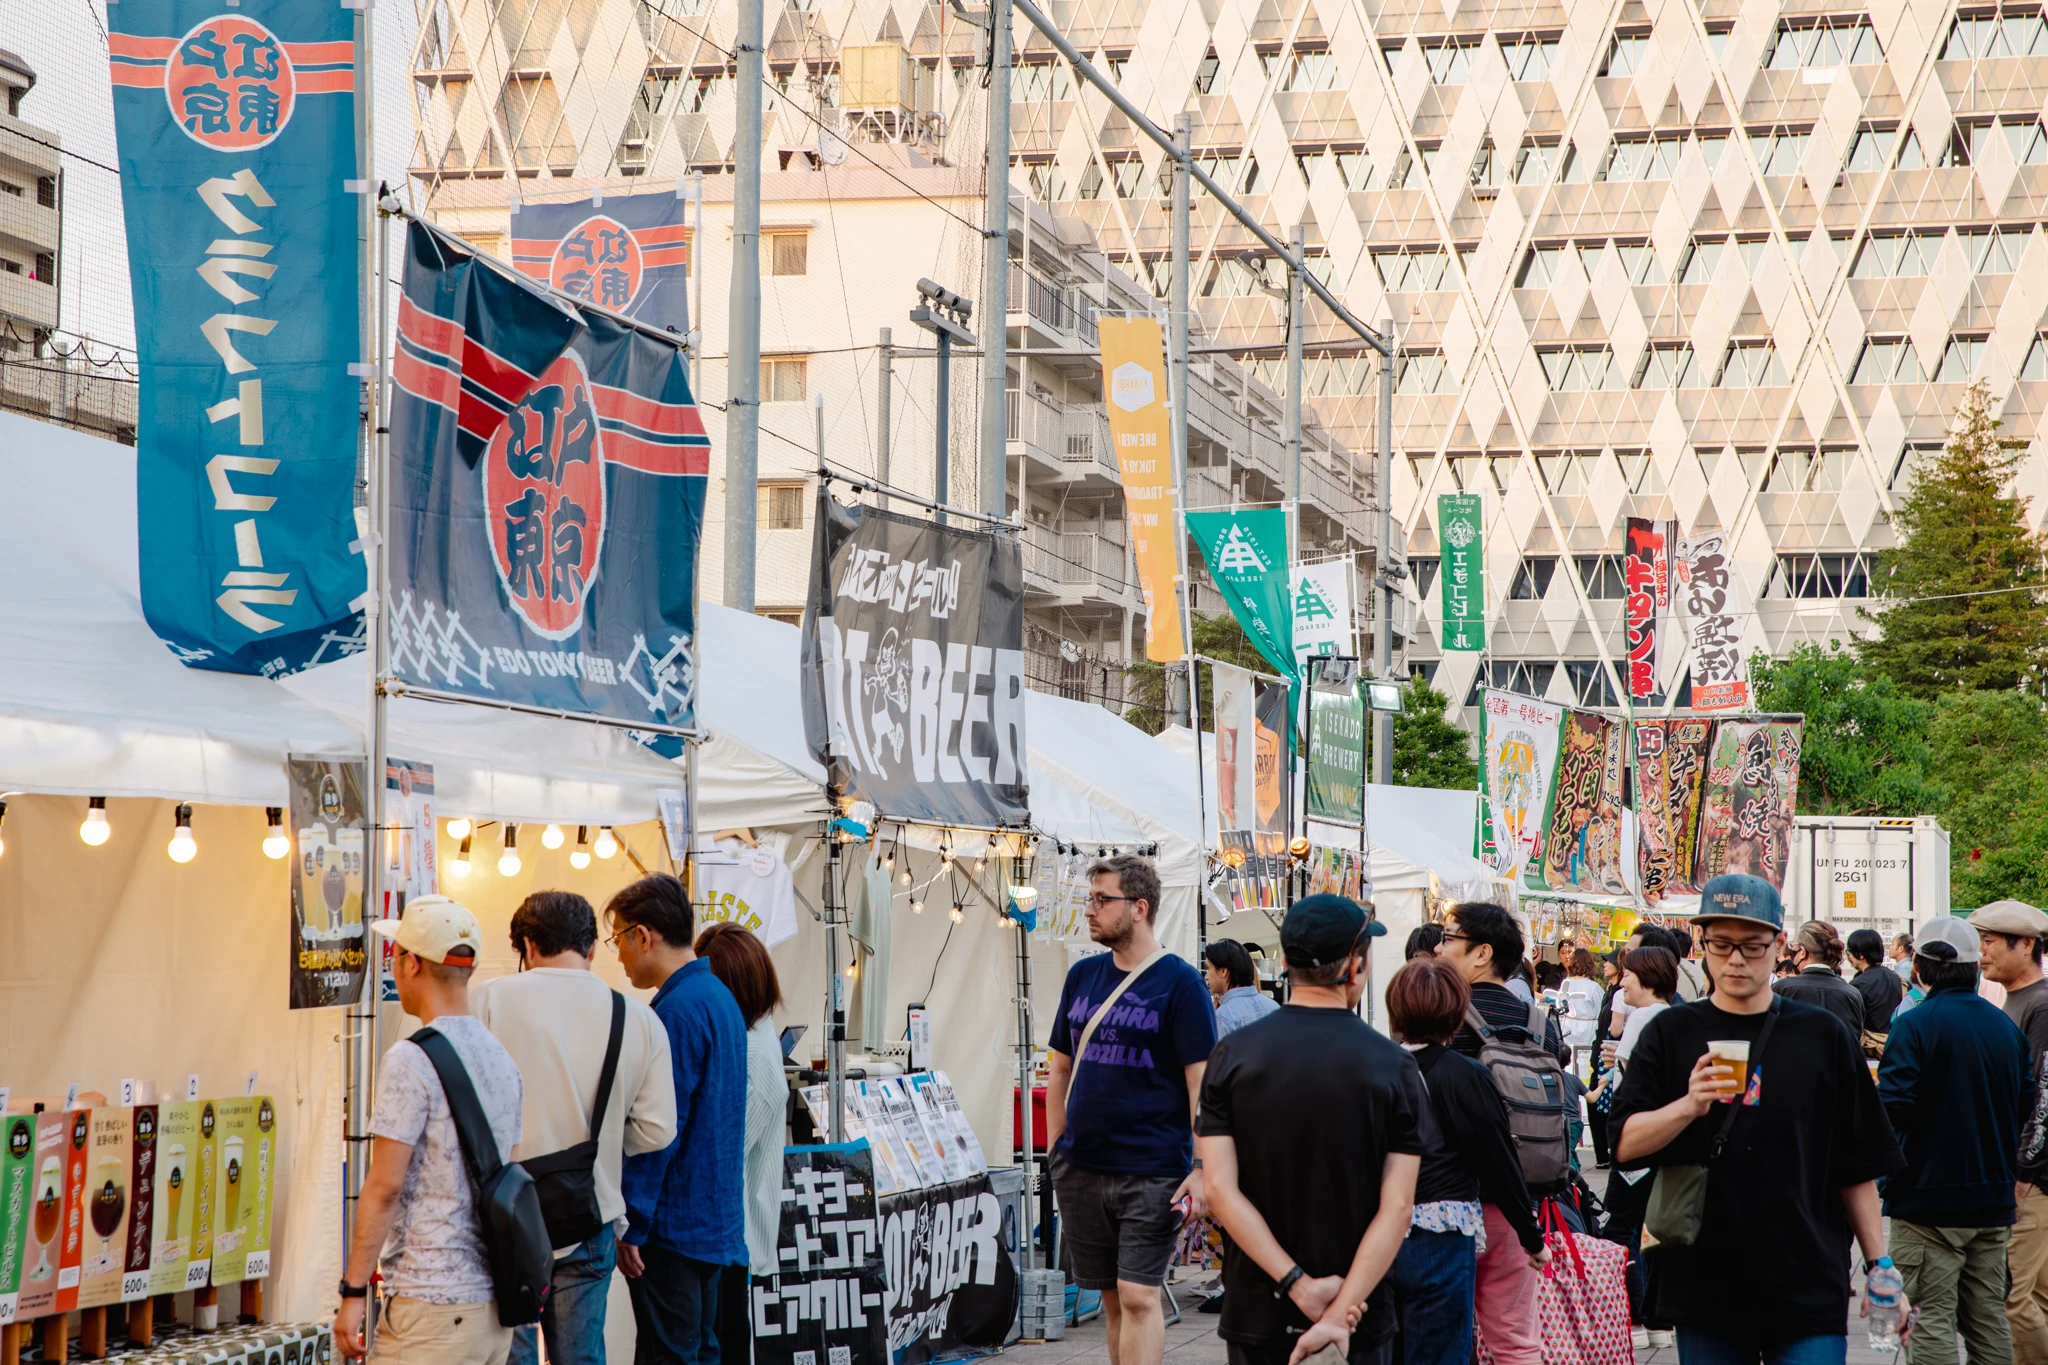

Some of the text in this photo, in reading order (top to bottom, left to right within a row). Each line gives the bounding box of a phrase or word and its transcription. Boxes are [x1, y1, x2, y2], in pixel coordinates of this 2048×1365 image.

[505, 382, 597, 488] 江戸
[504, 485, 589, 606] 東京
[1654, 558, 1668, 608] 極旨牛の
[1625, 554, 1656, 698] 牛タン串
[497, 646, 531, 676] EDO
[584, 656, 618, 686] BEER
[909, 637, 1030, 787] BEER
[1324, 710, 1361, 741] ISEKADO
[1484, 696, 1560, 727] 全国第一号地ビール
[1681, 726, 1701, 741] 極上
[1323, 743, 1360, 773] BREWERY
[1607, 722, 1621, 783] 新潟味処
[1548, 748, 1587, 868] からあげ
[1834, 871, 1868, 883] 25G1
[1900, 859, 1908, 869] 7
[699, 890, 763, 932] ASTE
[1713, 893, 1751, 905] NEW ERA
[323, 971, 350, 988] ¥1,200
[1099, 1027, 1119, 1042] VS.
[124, 1083, 132, 1104] 3
[190, 1078, 197, 1096] 2
[94, 1119, 128, 1133] 甘く香ばしい
[130, 1149, 154, 1268] デュンケル
[195, 1145, 213, 1254] ヴァイツェン
[0, 1166, 26, 1289] マスカットピルス
[929, 1191, 1002, 1300] BEER
[187, 1265, 209, 1282] 600円
[247, 1258, 270, 1275] 600円
[123, 1277, 148, 1294] 600円
[752, 1273, 881, 1338] ビアクルー
